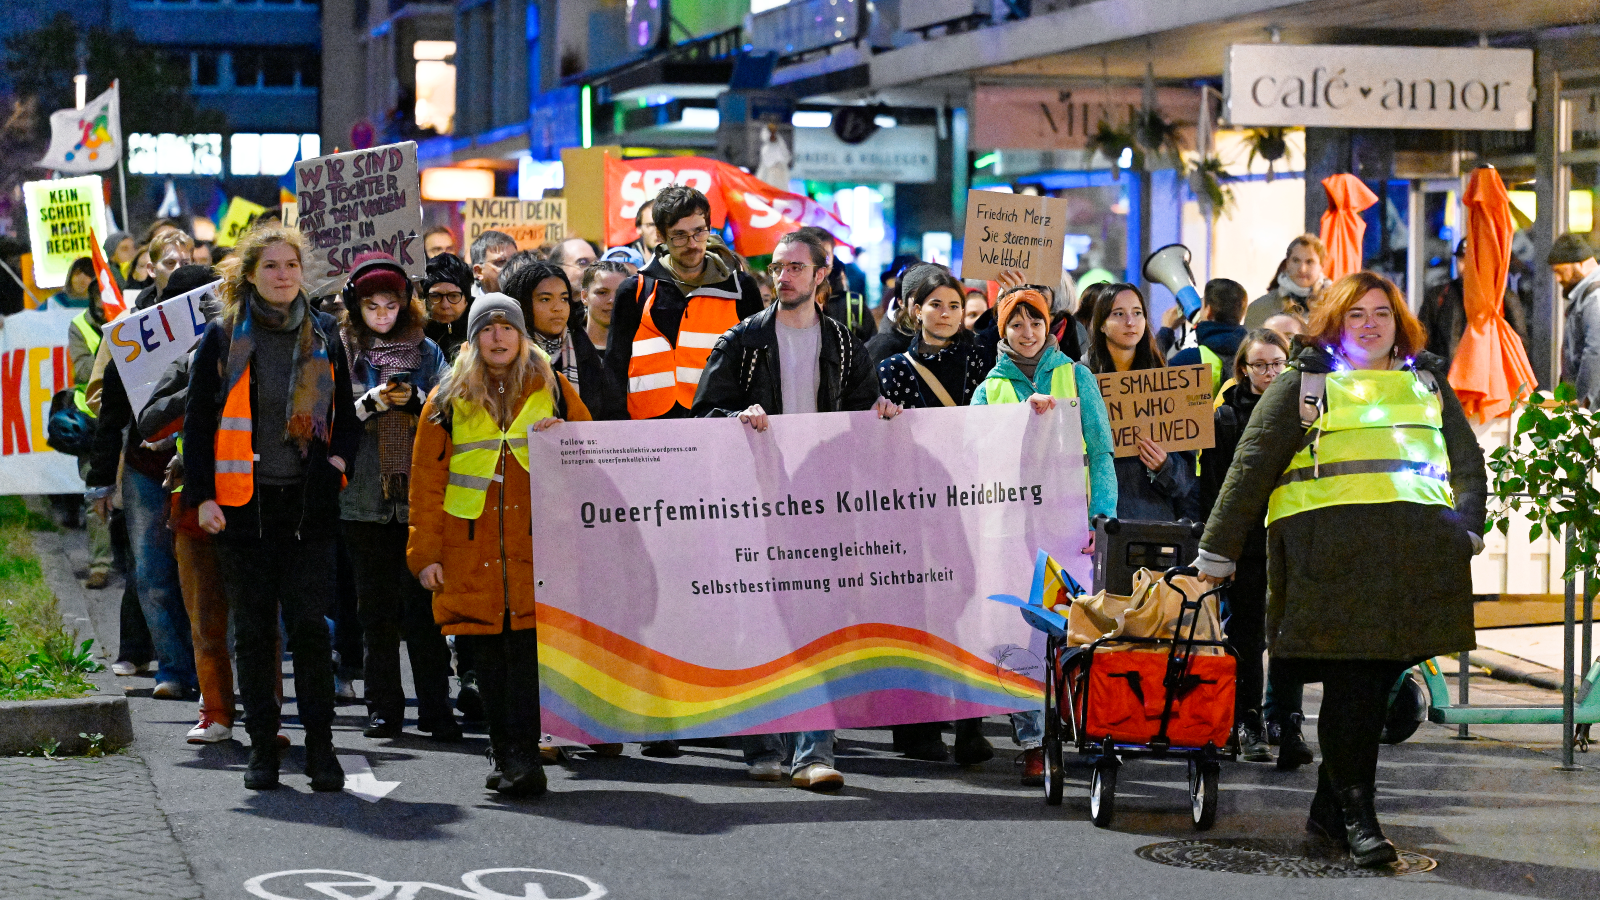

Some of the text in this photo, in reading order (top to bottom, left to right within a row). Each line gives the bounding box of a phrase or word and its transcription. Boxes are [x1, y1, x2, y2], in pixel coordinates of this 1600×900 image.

[1251, 66, 1510, 112] café amor
[300, 147, 403, 190] WIR SIND
[49, 187, 79, 204] KEIN
[40, 202, 91, 222] SCHRITT
[472, 200, 562, 219] NICHT DEIN
[977, 203, 1018, 223] Friedrich
[51, 220, 86, 237] NACH
[981, 225, 999, 243] Sie
[1030, 236, 1053, 248] mein
[46, 236, 92, 254] RECHTS
[979, 246, 1031, 269] Weltbild
[1120, 367, 1205, 395] SMALLEST
[1133, 397, 1175, 418] WHO
[560, 438, 584, 446] Follow
[1110, 418, 1200, 447] VER LIVED
[560, 446, 698, 456] queerfeministischeskollektiv.wordpress.com
[580, 482, 1043, 528] Queerfeministisches Kollektiv Heidelberg
[735, 540, 908, 562] Für Chancengleichheit,
[691, 566, 954, 595] Selbstbestimmung und Sichtbarkeit
